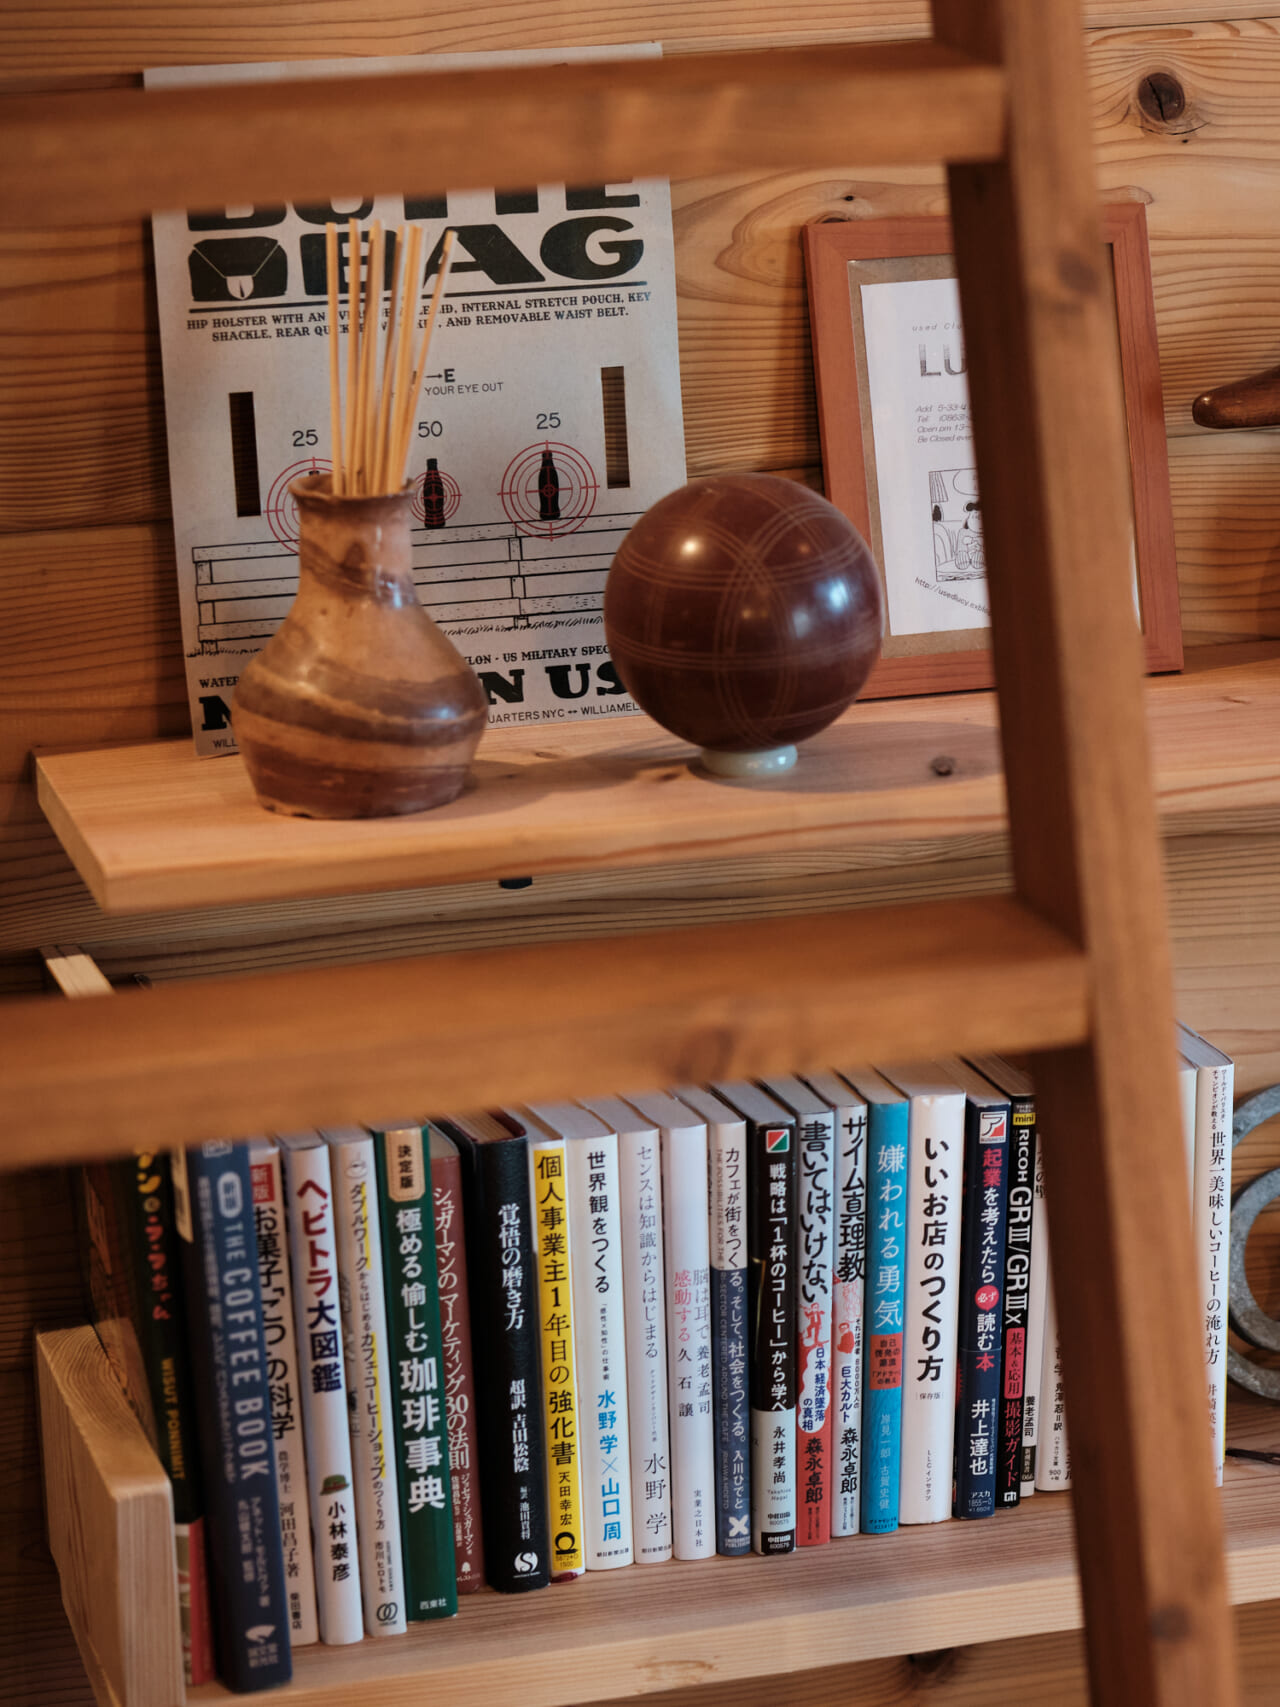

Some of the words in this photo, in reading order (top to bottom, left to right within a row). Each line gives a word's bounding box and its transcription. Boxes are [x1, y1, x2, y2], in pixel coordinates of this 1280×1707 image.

[187, 319, 208, 330] HIP
[213, 315, 268, 328] HOLSTER
[272, 313, 304, 325] WITH
[308, 311, 326, 322] AN
[276, 326, 311, 339] REAR
[315, 323, 349, 337] QUK
[436, 302, 459, 315] ID,
[462, 300, 522, 313] INTERNAL
[525, 296, 578, 309] STRETCH
[628, 291, 652, 303] KEY
[446, 317, 472, 328] AND
[476, 312, 551, 326] REMOVABLE
[555, 309, 593, 320] WAIST
[597, 306, 629, 318] BELT.
[424, 384, 455, 396] YOUR
[457, 383, 479, 394] EYE
[481, 381, 505, 393] OUT
[918, 343, 969, 377] LU
[293, 429, 319, 447] 25
[418, 420, 444, 438] 50
[536, 412, 562, 430] 25
[478, 669, 525, 705] N
[545, 660, 630, 699] US
[503, 652, 518, 662] US
[522, 647, 578, 661] MILITARY
[487, 710, 541, 724] UARTERS
[542, 708, 565, 719] NYC
[580, 702, 640, 716] WILLIAMEL
[1015, 1114, 1035, 1123] mini
[398, 1145, 414, 1189] 決定版
[1017, 1128, 1030, 1182] RICOH
[586, 1151, 611, 1293] 世界観をつくる
[800, 1120, 833, 1303] 書いてはいけない
[837, 1116, 868, 1283] ザイム真理教
[224, 1221, 247, 1262] THE
[498, 1203, 526, 1332] 覚悟の磨き方
[636, 1146, 659, 1359] センスは知識からはじまる
[874, 1145, 905, 1329] 嫌われる勇気
[917, 1137, 950, 1382] いいお店のつくり方
[1204, 1131, 1227, 1366] 世界一美味しいコーヒーの淹れ方
[297, 1178, 342, 1394] ヘビトラ大図鑑
[537, 1154, 576, 1466] 個人事業主1年目の強化書
[674, 1270, 692, 1342] 感動する
[693, 1268, 711, 1340] 脳は耳で
[223, 1267, 262, 1387] COFFEE
[255, 1206, 295, 1440] お菓子「こつの科学
[677, 1347, 694, 1418] 久石譲
[697, 1345, 711, 1415] 養老孟司
[840, 1365, 853, 1423] 巨大カルト
[235, 1397, 270, 1481] BOOK
[512, 1414, 530, 1474] 吉田松陰
[802, 1398, 814, 1431] の真相
[969, 1399, 990, 1476] 井上達也
[1004, 1400, 1022, 1488] 撮影ガイド
[1023, 1396, 1035, 1438] 養老孟司
[732, 1450, 745, 1510] 入川ひでと
[773, 1426, 786, 1484] 永井孝尚
[804, 1437, 824, 1504] 森永卓郎
[840, 1427, 859, 1494] 森永卓郎
[558, 1471, 573, 1526] 天田幸宏
[644, 1453, 667, 1535] 水野学
[328, 1501, 350, 1582] 小林泰彦
